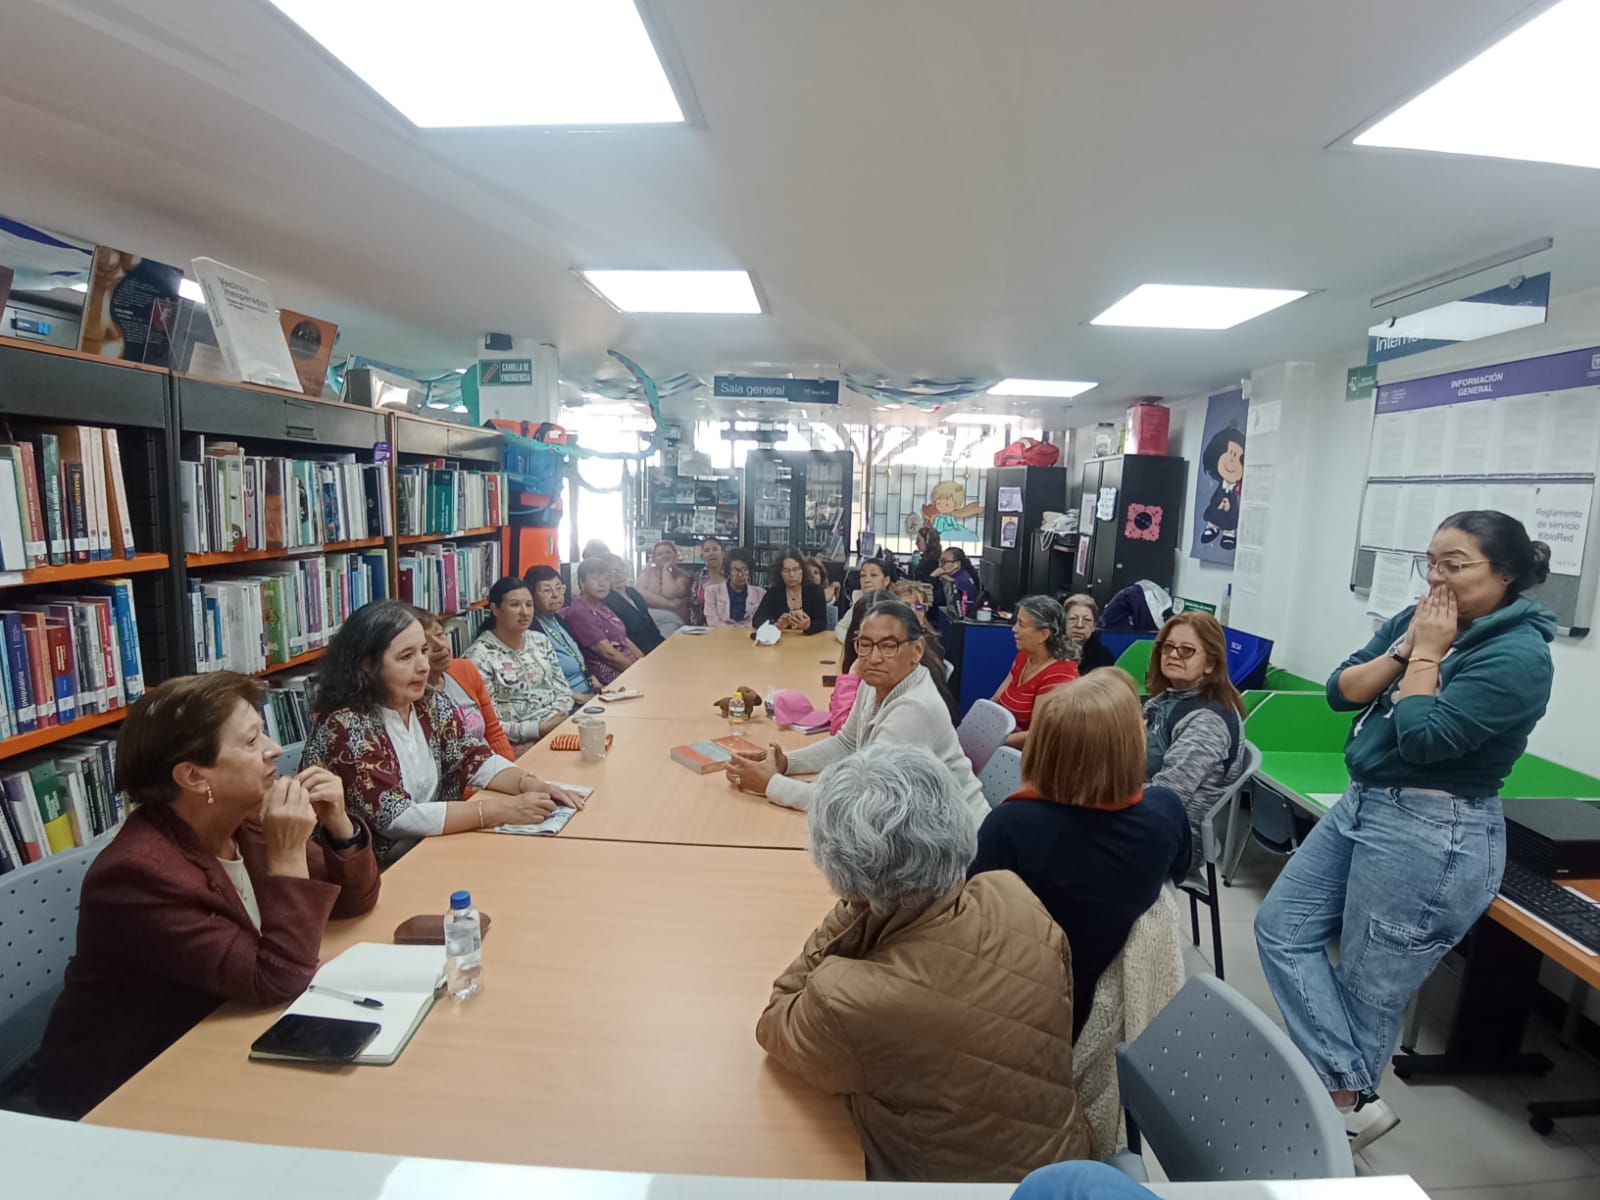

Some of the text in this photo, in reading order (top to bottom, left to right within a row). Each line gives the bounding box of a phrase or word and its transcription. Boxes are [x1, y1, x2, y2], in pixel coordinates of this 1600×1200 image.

[1450, 372, 1504, 388] INFORMACIÓN
[720, 382, 785, 396] Sala general
[1458, 384, 1494, 397] GENERAL
[1536, 508, 1583, 519] Reglamento
[1537, 520, 1580, 530] de servicio
